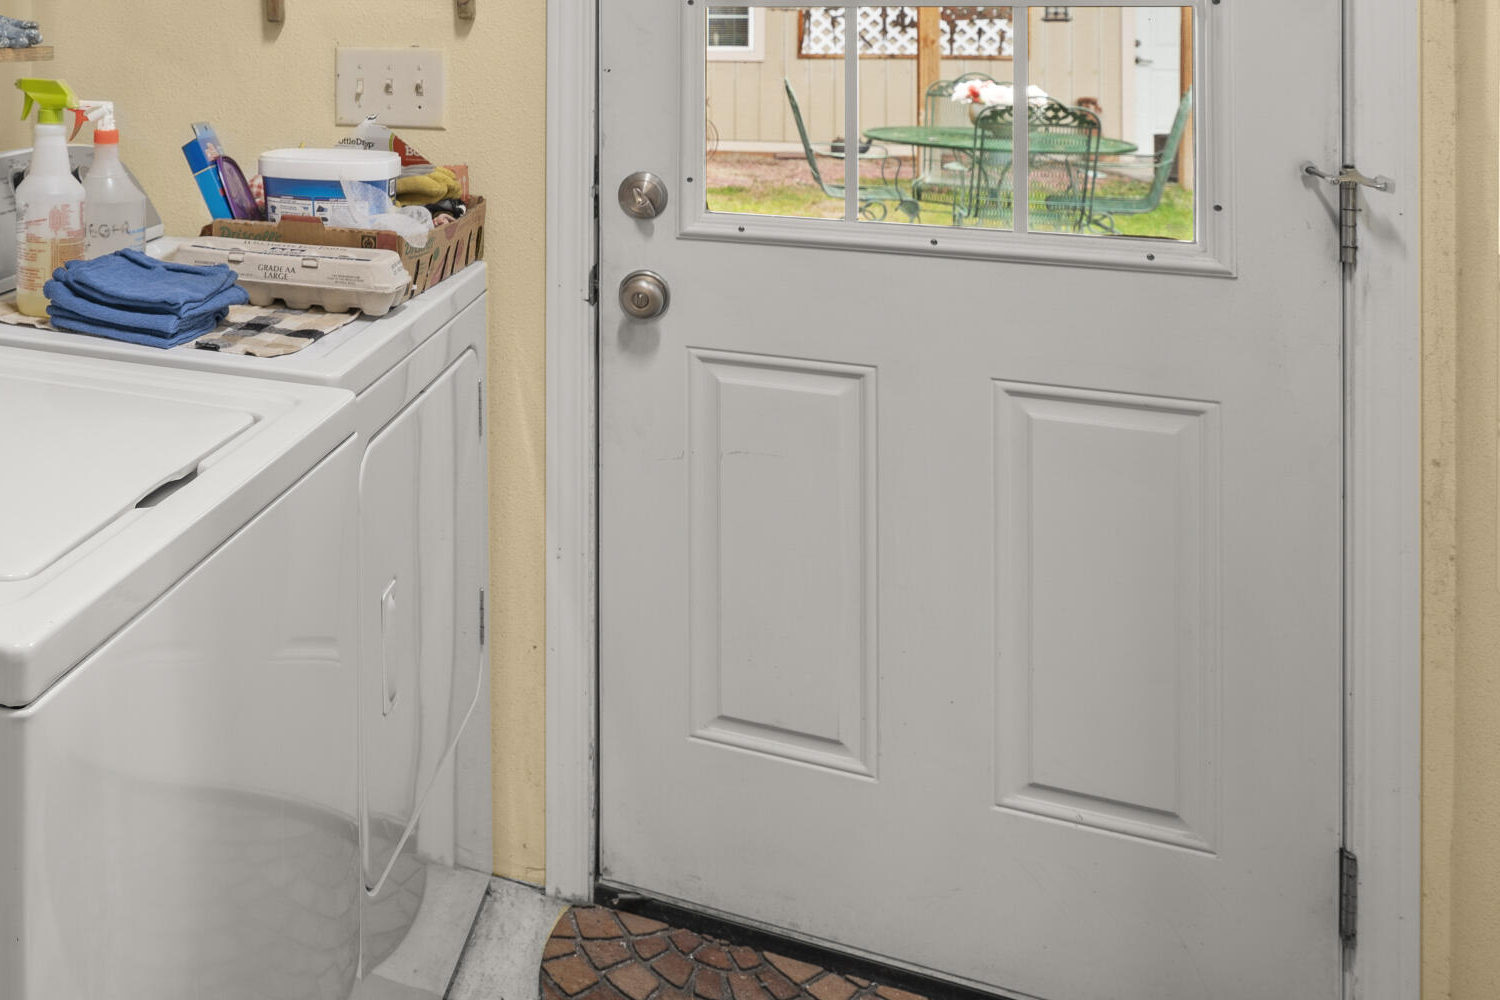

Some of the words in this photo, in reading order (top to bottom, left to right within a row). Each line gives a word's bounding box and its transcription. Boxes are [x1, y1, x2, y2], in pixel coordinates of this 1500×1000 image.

[257, 263, 284, 273] GRADE
[284, 265, 296, 274] AA
[263, 271, 289, 281] LARGE
